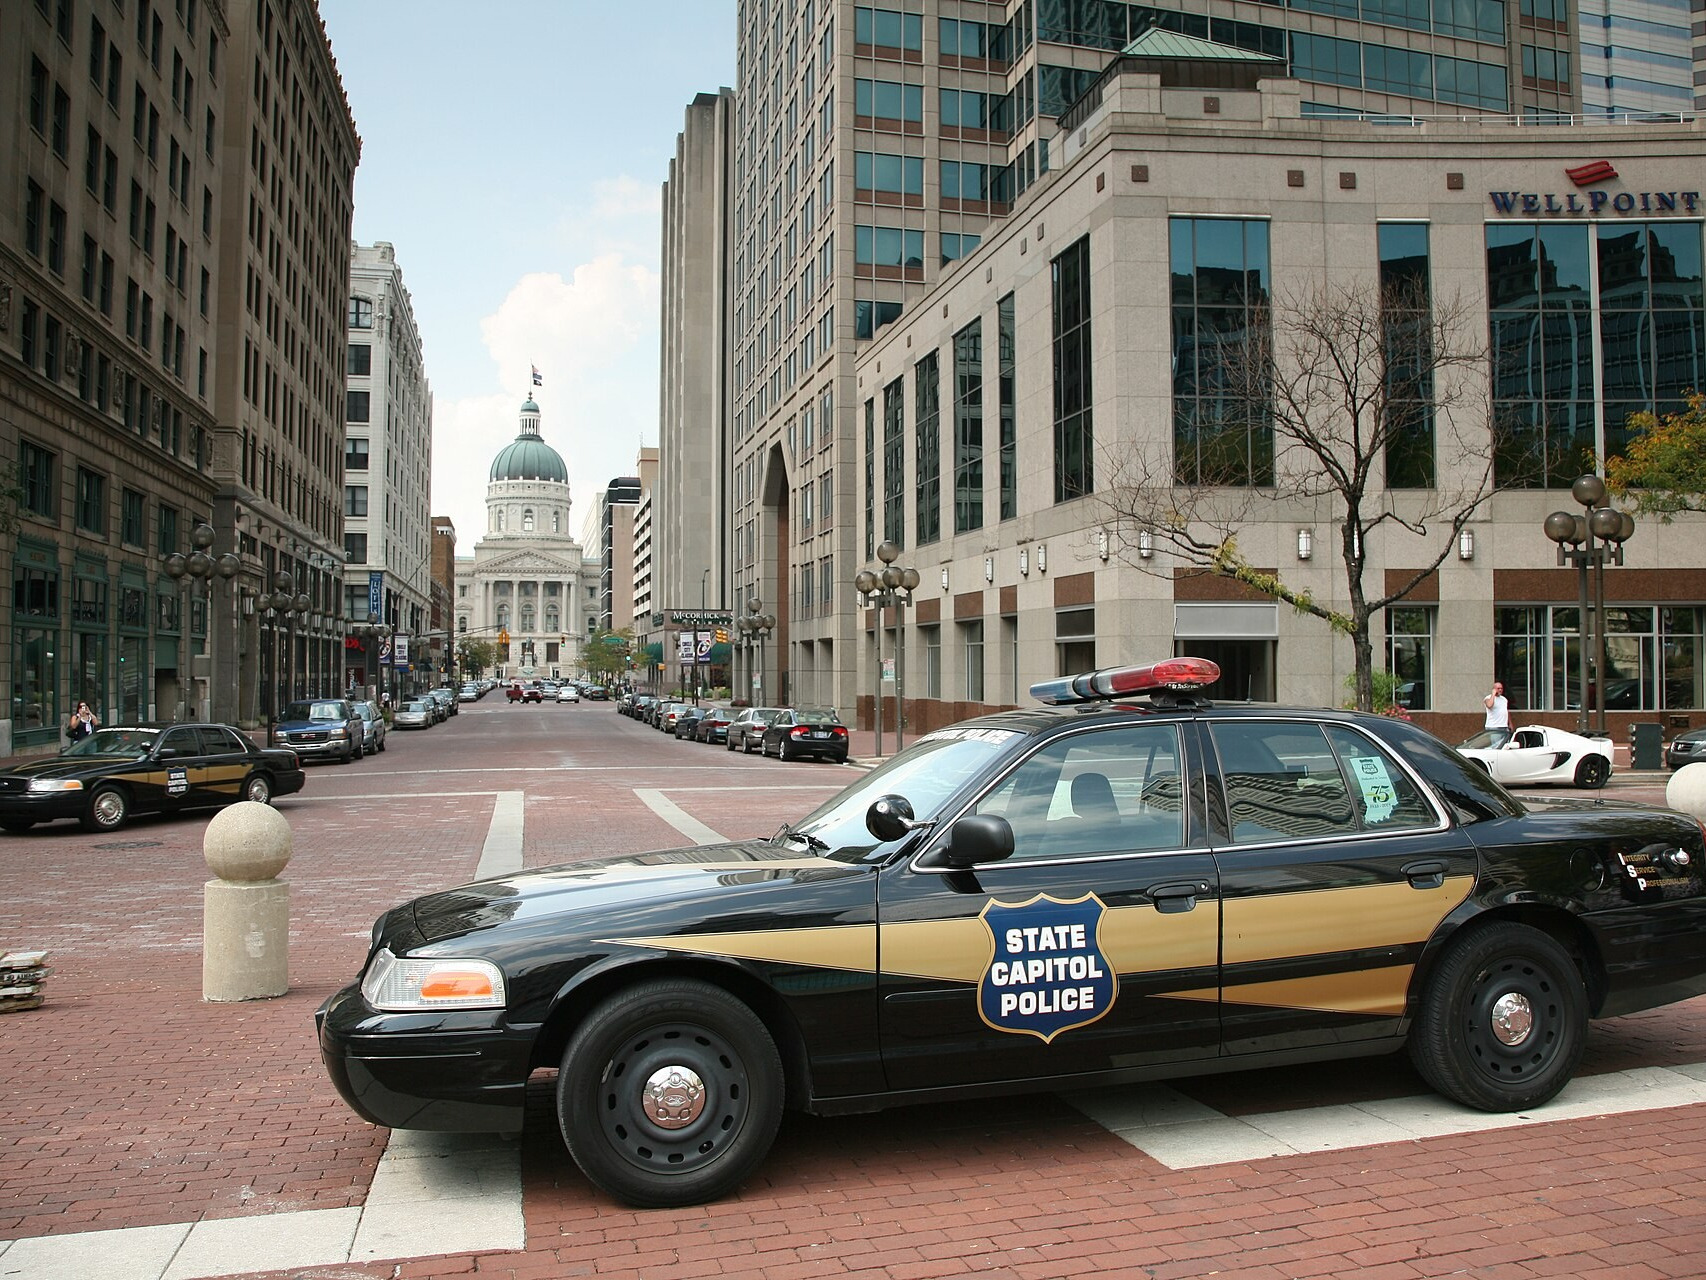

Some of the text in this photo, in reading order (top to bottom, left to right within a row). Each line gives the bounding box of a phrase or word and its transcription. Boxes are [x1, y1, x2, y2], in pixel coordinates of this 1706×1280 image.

[168, 785, 187, 793] POLICE
[1370, 785, 1390, 804] 75
[1617, 852, 1651, 866] INTEGRITY
[1626, 864, 1656, 878] SERVICE
[1006, 923, 1086, 954] STATE
[991, 954, 1103, 987] CAPITOL
[1000, 986, 1094, 1017] POLICE
